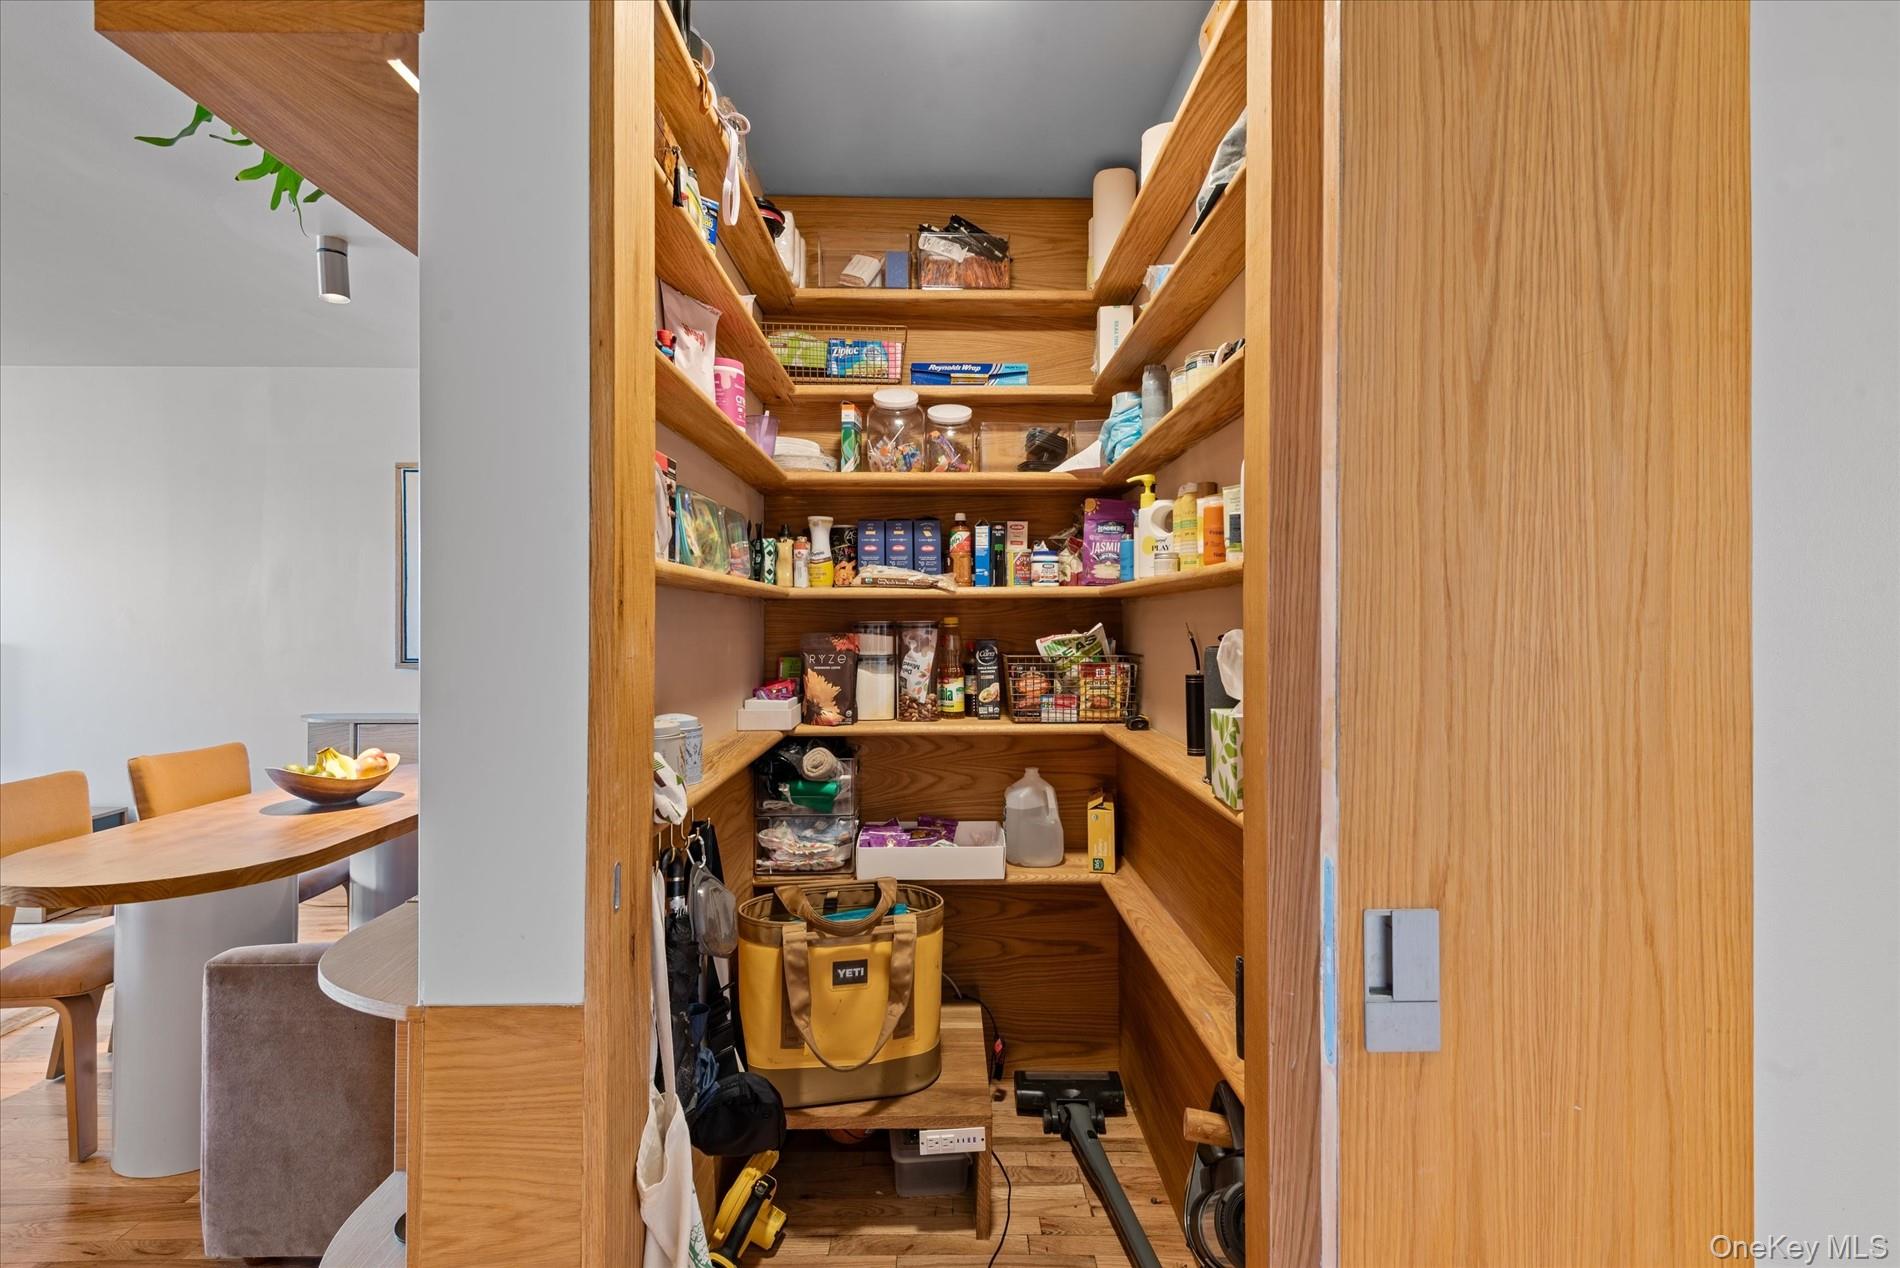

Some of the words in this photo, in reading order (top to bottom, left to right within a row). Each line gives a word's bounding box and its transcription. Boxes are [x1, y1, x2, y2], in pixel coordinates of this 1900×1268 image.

[832, 346, 859, 358] Ziploc
[928, 364, 961, 372] Reynolds
[961, 364, 981, 372] Wrap
[837, 967, 864, 978] YETI
